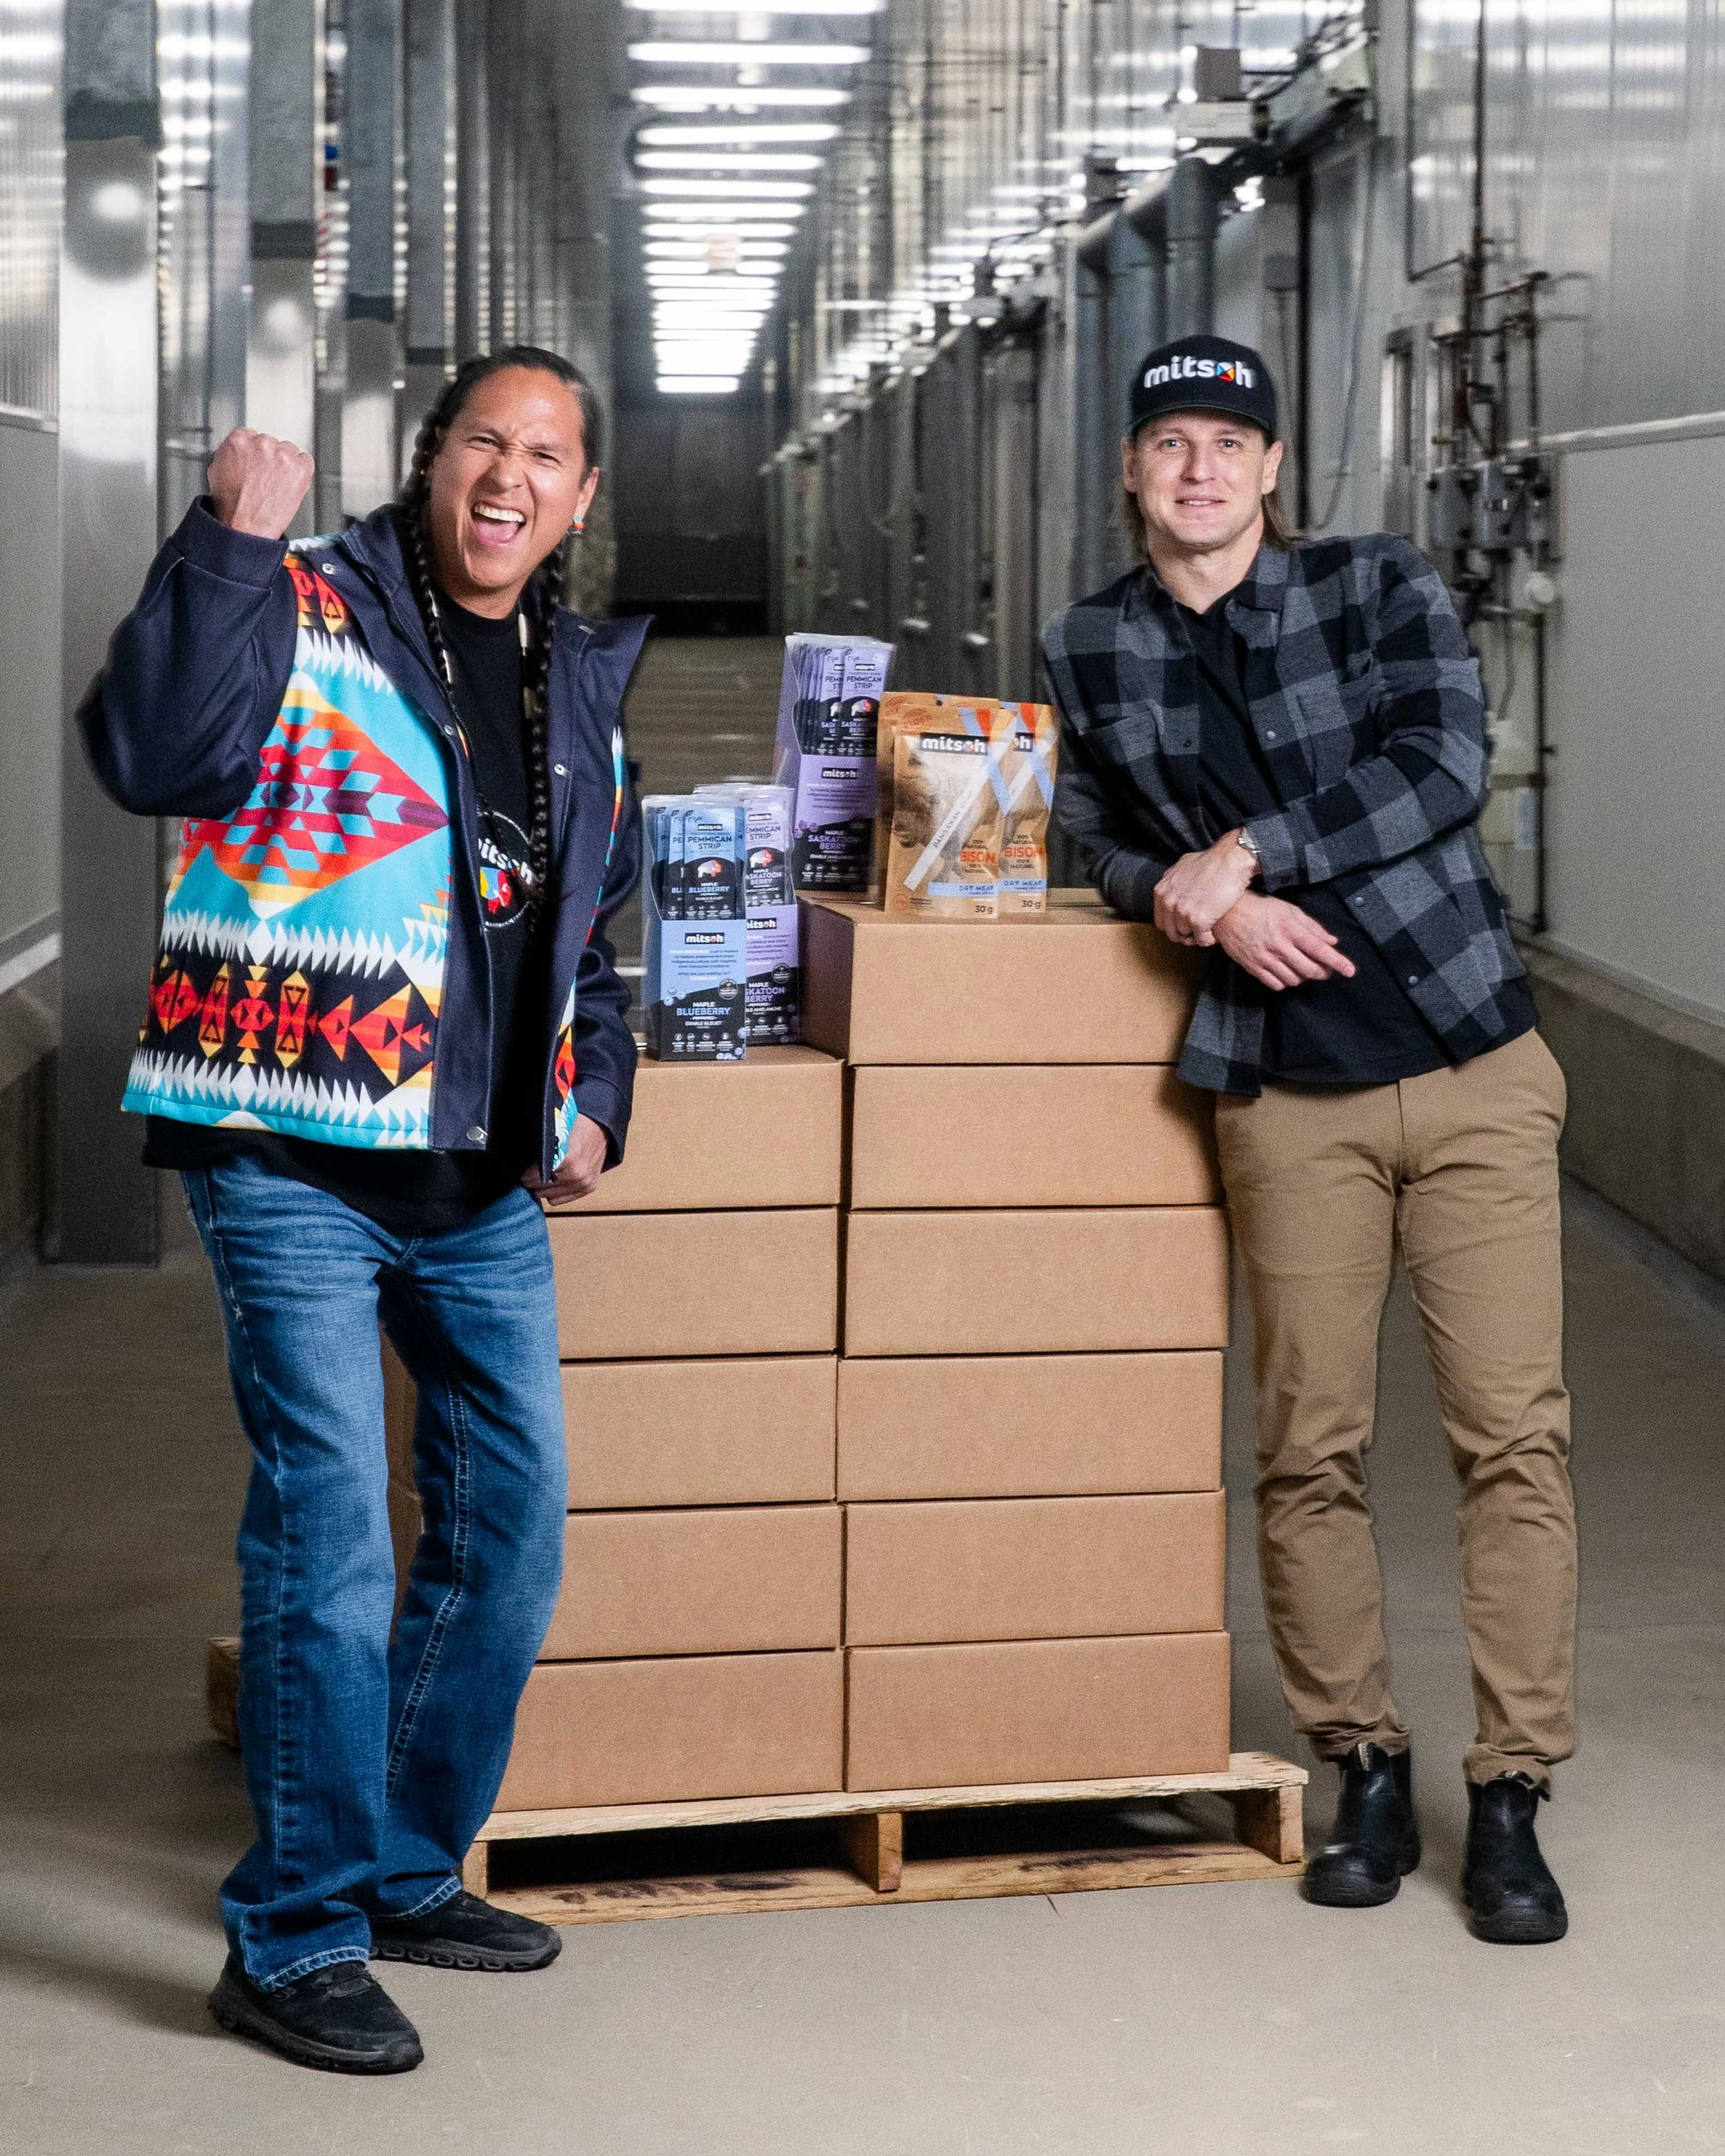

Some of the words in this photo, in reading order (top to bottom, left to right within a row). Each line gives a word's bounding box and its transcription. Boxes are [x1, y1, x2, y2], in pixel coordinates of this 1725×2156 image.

[1144, 355, 1253, 388] mitsoh
[922, 735, 986, 753] mitsoh
[822, 769, 856, 778] mitsoh
[960, 850, 997, 864] BISON
[1004, 846, 1044, 858] BISON
[686, 933, 724, 943] mitsoh
[745, 987, 785, 996] SKATOON
[677, 1007, 731, 1016] BLUEBERRY
